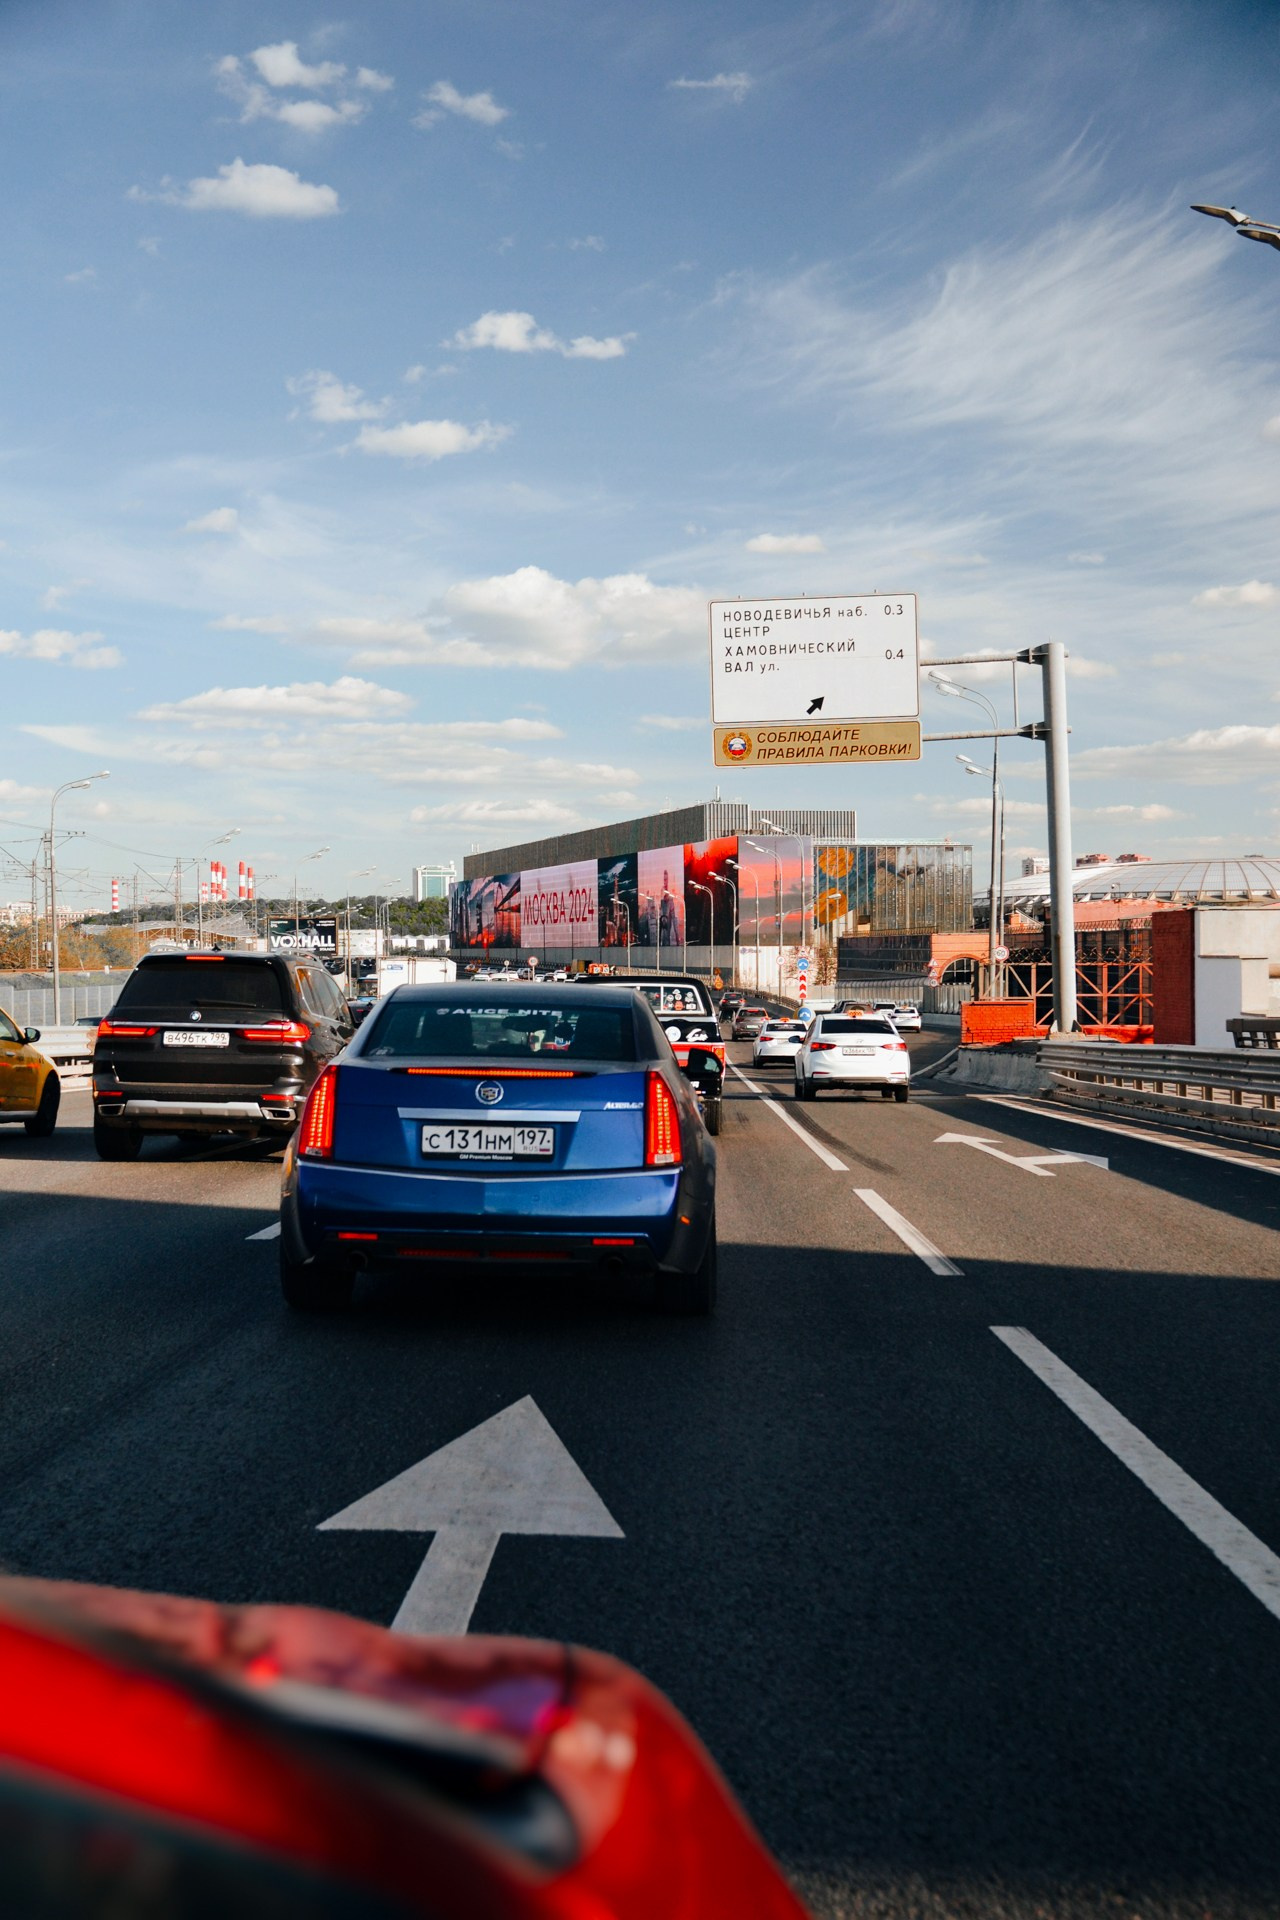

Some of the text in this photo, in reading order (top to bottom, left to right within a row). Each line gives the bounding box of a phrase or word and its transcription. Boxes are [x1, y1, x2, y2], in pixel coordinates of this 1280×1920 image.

[723, 604, 903, 622] НОВОДЕВИЧЬЯ наб. 0.3
[723, 626, 770, 639] ЦЕНТР
[724, 638, 856, 657] ХАМОВНИЧЕСКИЙ
[885, 649, 904, 660] 0.4
[724, 661, 780, 674] ВАЛ ул.
[757, 728, 860, 744] СОБЛЮДАЙТЕ
[756, 743, 912, 760] ПРАВИЛА ПАРКОВКИ!
[523, 887, 594, 926] МОСКВА 2024
[270, 935, 335, 948] VOXHALL
[518, 1009, 563, 1017] NITE
[517, 1129, 547, 1145] 197
